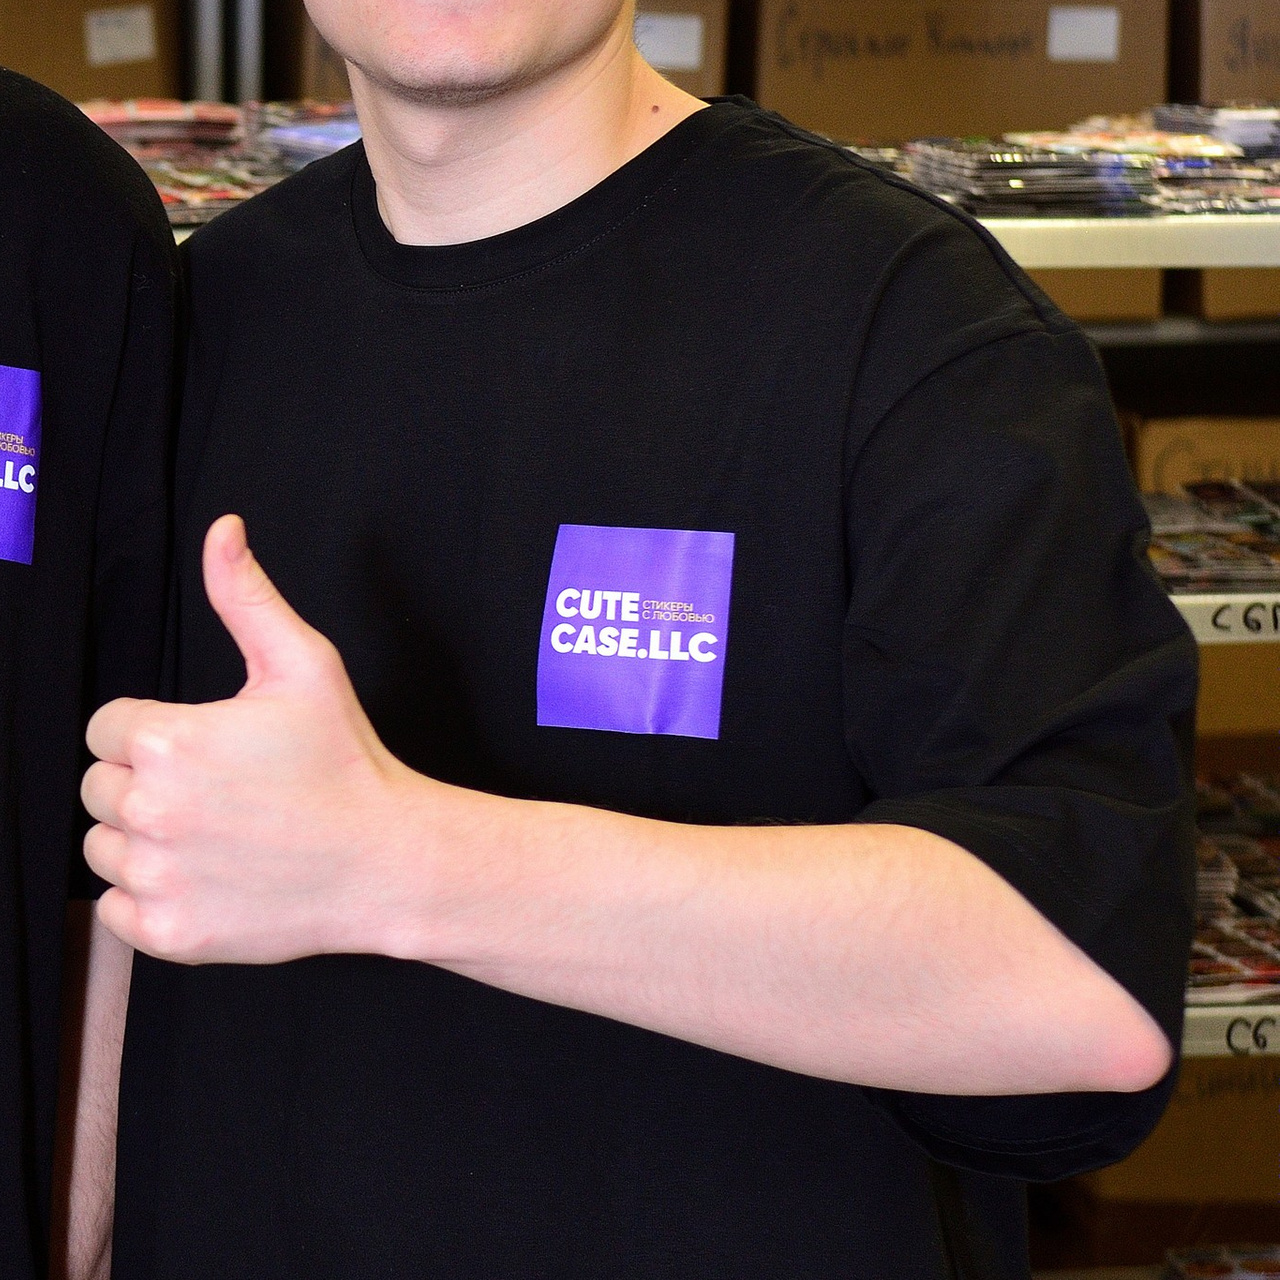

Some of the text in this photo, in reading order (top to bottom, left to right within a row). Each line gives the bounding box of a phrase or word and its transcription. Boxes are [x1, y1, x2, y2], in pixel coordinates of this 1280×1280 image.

[555, 587, 641, 623] CUTE
[642, 600, 694, 612] СТИКЕРЫ
[642, 610, 716, 624] С ЛЮБОВЬЮ
[550, 623, 719, 663] CASE.LLC
